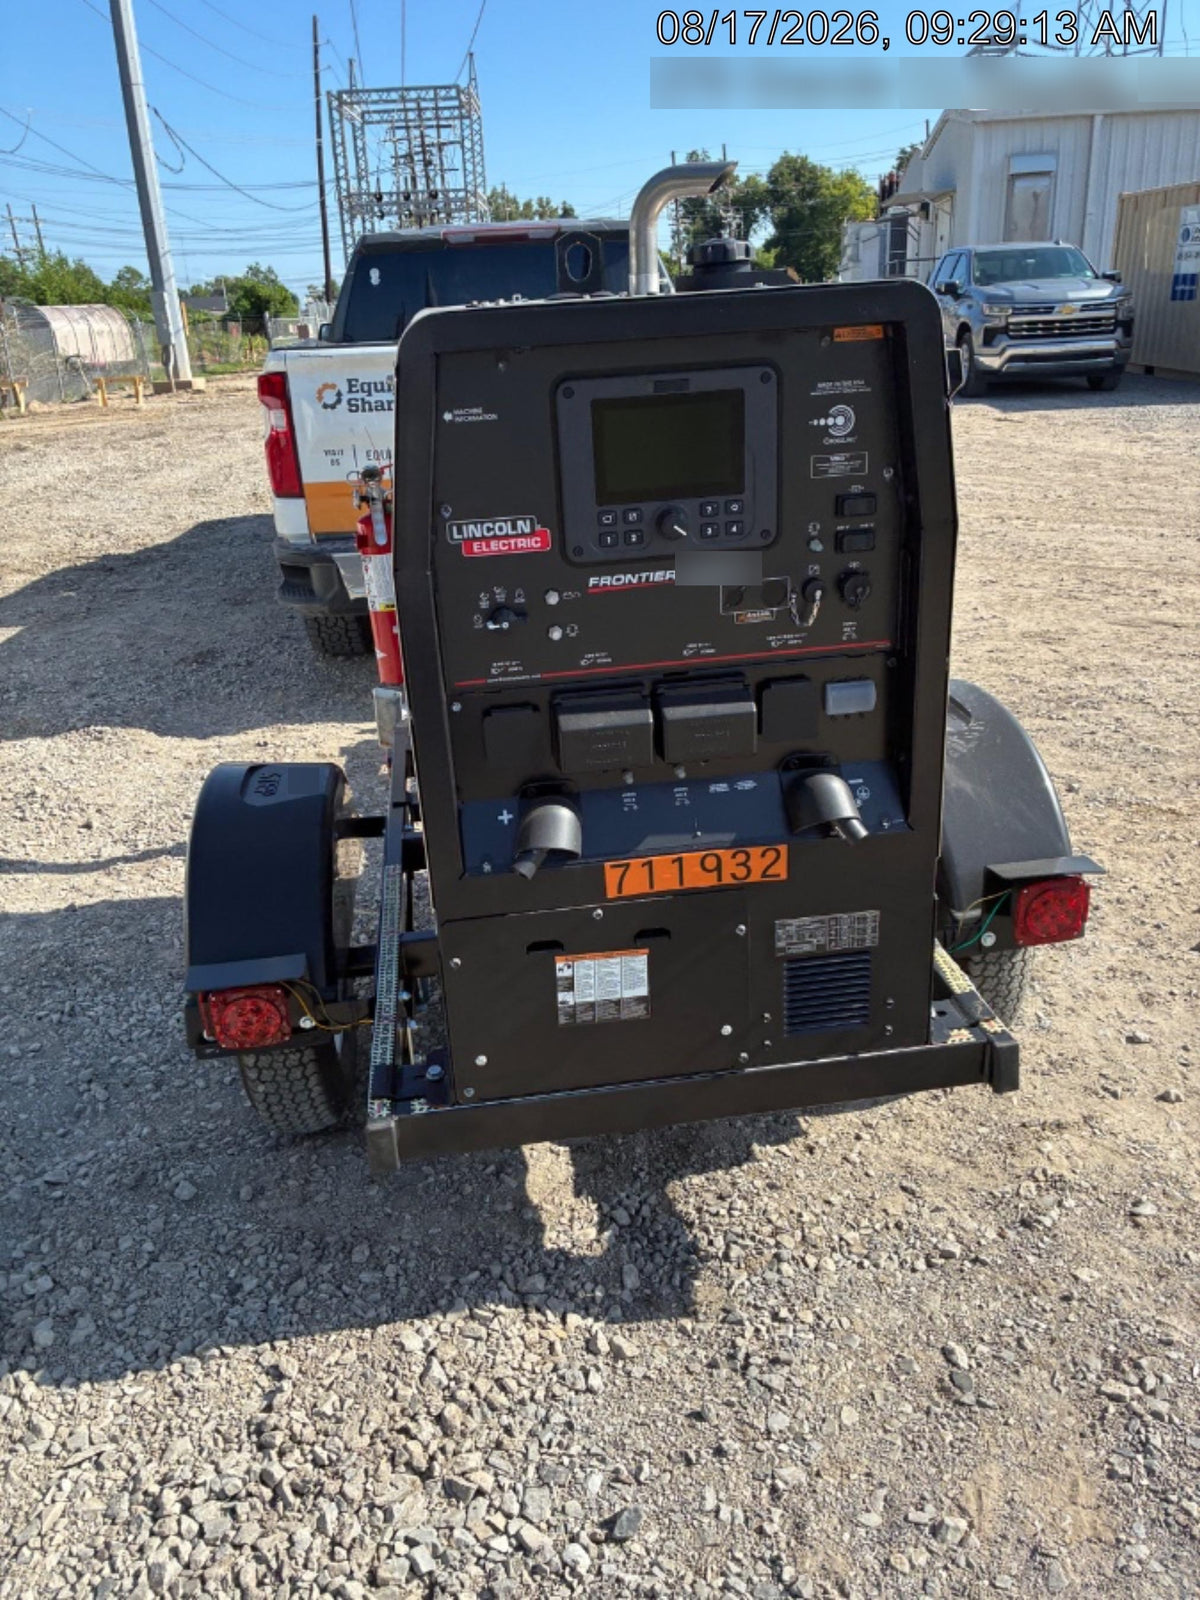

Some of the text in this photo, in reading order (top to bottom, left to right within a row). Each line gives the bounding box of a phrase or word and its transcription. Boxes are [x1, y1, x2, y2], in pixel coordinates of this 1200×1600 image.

[452, 519, 531, 539] LINCOLN
[472, 536, 542, 553] ELECTRIC
[588, 569, 676, 588] FRONTIER
[609, 847, 781, 895] 711932
